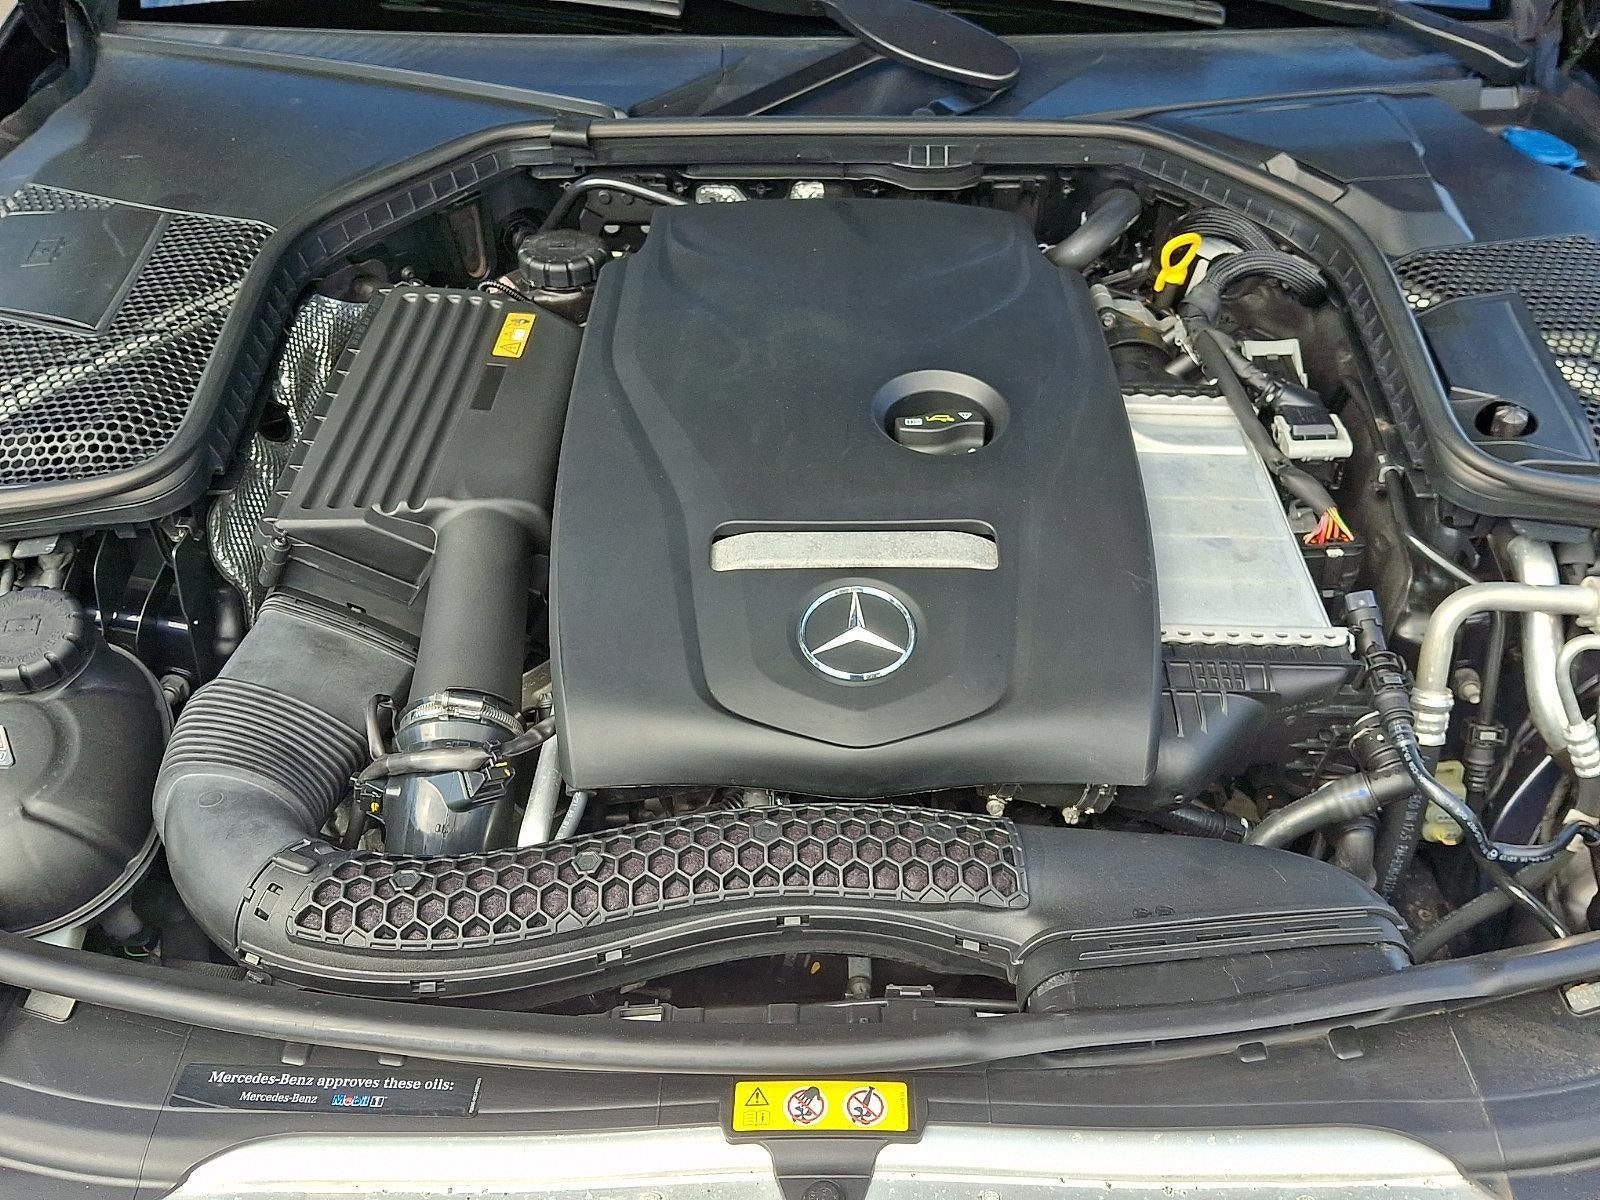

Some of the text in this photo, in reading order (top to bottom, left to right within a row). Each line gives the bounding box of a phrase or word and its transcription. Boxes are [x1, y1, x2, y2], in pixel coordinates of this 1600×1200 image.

[208, 1070, 455, 1091] Mercedes-Benz approves these oils:
[238, 1091, 319, 1105] Mercedes-Benz
[331, 1094, 370, 1107] Mobil
